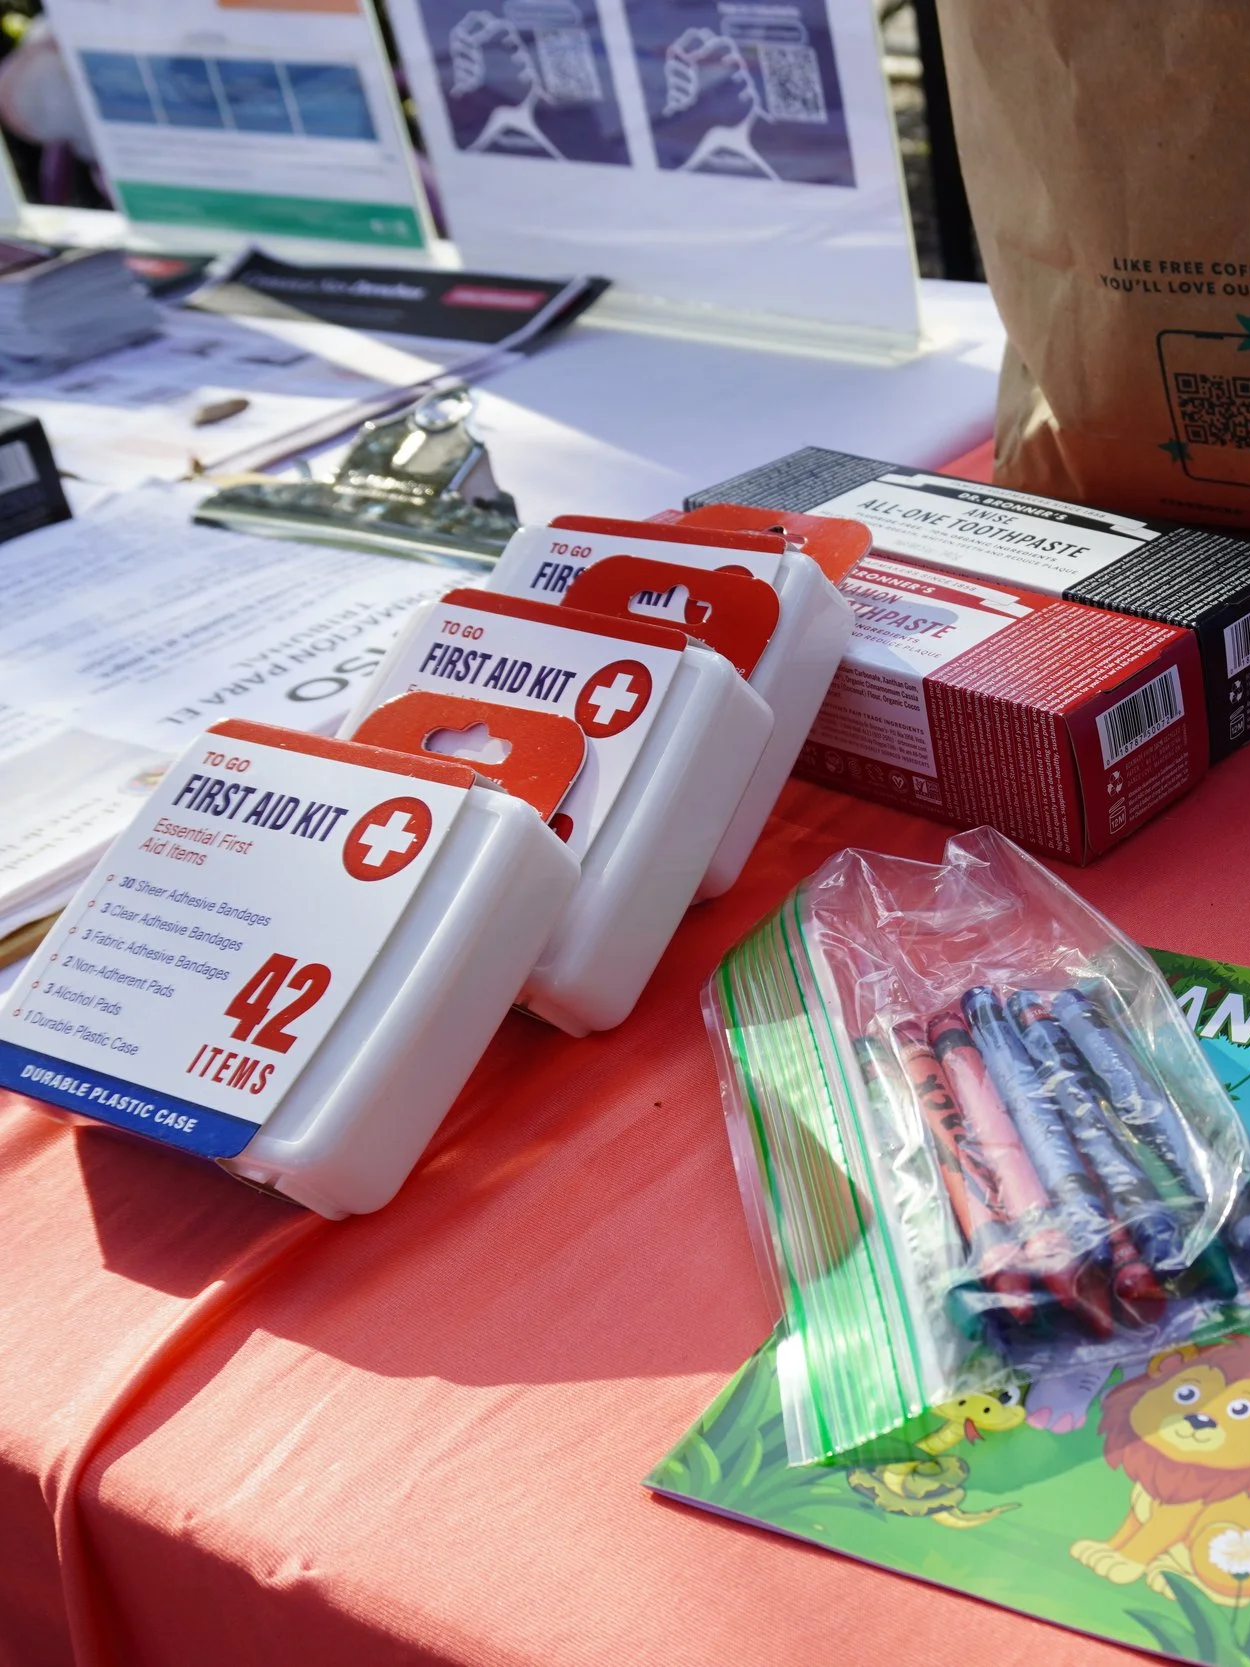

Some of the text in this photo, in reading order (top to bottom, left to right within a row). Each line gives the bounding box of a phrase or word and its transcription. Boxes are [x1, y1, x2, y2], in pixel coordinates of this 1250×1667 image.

[1112, 257, 1152, 273] LIKE
[1159, 261, 1205, 275] FREE
[1100, 274, 1161, 293] YOU'LL
[1168, 280, 1216, 295] LOVE
[957, 492, 1068, 521] DR. BRONNER'S
[961, 508, 1019, 525] ANISE
[856, 499, 951, 525] ALL-ONE
[947, 518, 1091, 559] TOOTHPASTE
[550, 542, 592, 558] TO GO
[950, 534, 1058, 562] ORGANIC INGREDIENTS
[1005, 554, 1042, 567] REDUCE
[1042, 563, 1080, 576] PLAQUE
[841, 582, 902, 605] NAMON
[922, 573, 978, 592] SINCE 1858
[440, 620, 484, 641] TO GO
[848, 600, 957, 639] THPASTE
[855, 623, 921, 644] INGREDIENTS
[864, 635, 943, 659] REDUCE PLAQUE
[419, 642, 492, 686] FIRST
[483, 656, 532, 694] AID
[526, 664, 577, 703] KIT
[1119, 716, 1171, 756] 18787 50072
[202, 751, 251, 772] TO GO
[171, 773, 350, 842] FIRST AID KIT
[138, 836, 207, 866] Aid Items
[152, 817, 254, 855] Essential First
[118, 876, 272, 928] 30 Sheer Adhesive Bandages
[100, 902, 243, 952] 3 Clear Adhesive Bandages
[81, 928, 231, 982] 3 Fabric Adhesive Bandages
[62, 955, 176, 999] 2 Non-Adherent Pads
[43, 982, 123, 1017] 3 Alcohol Pads
[224, 952, 332, 1055] 42
[24, 1010, 140, 1056] 1 Durable Plastic Case
[185, 1043, 276, 1096] ITEMS
[20, 1063, 199, 1134] DURABLE PLASTIC CASE
